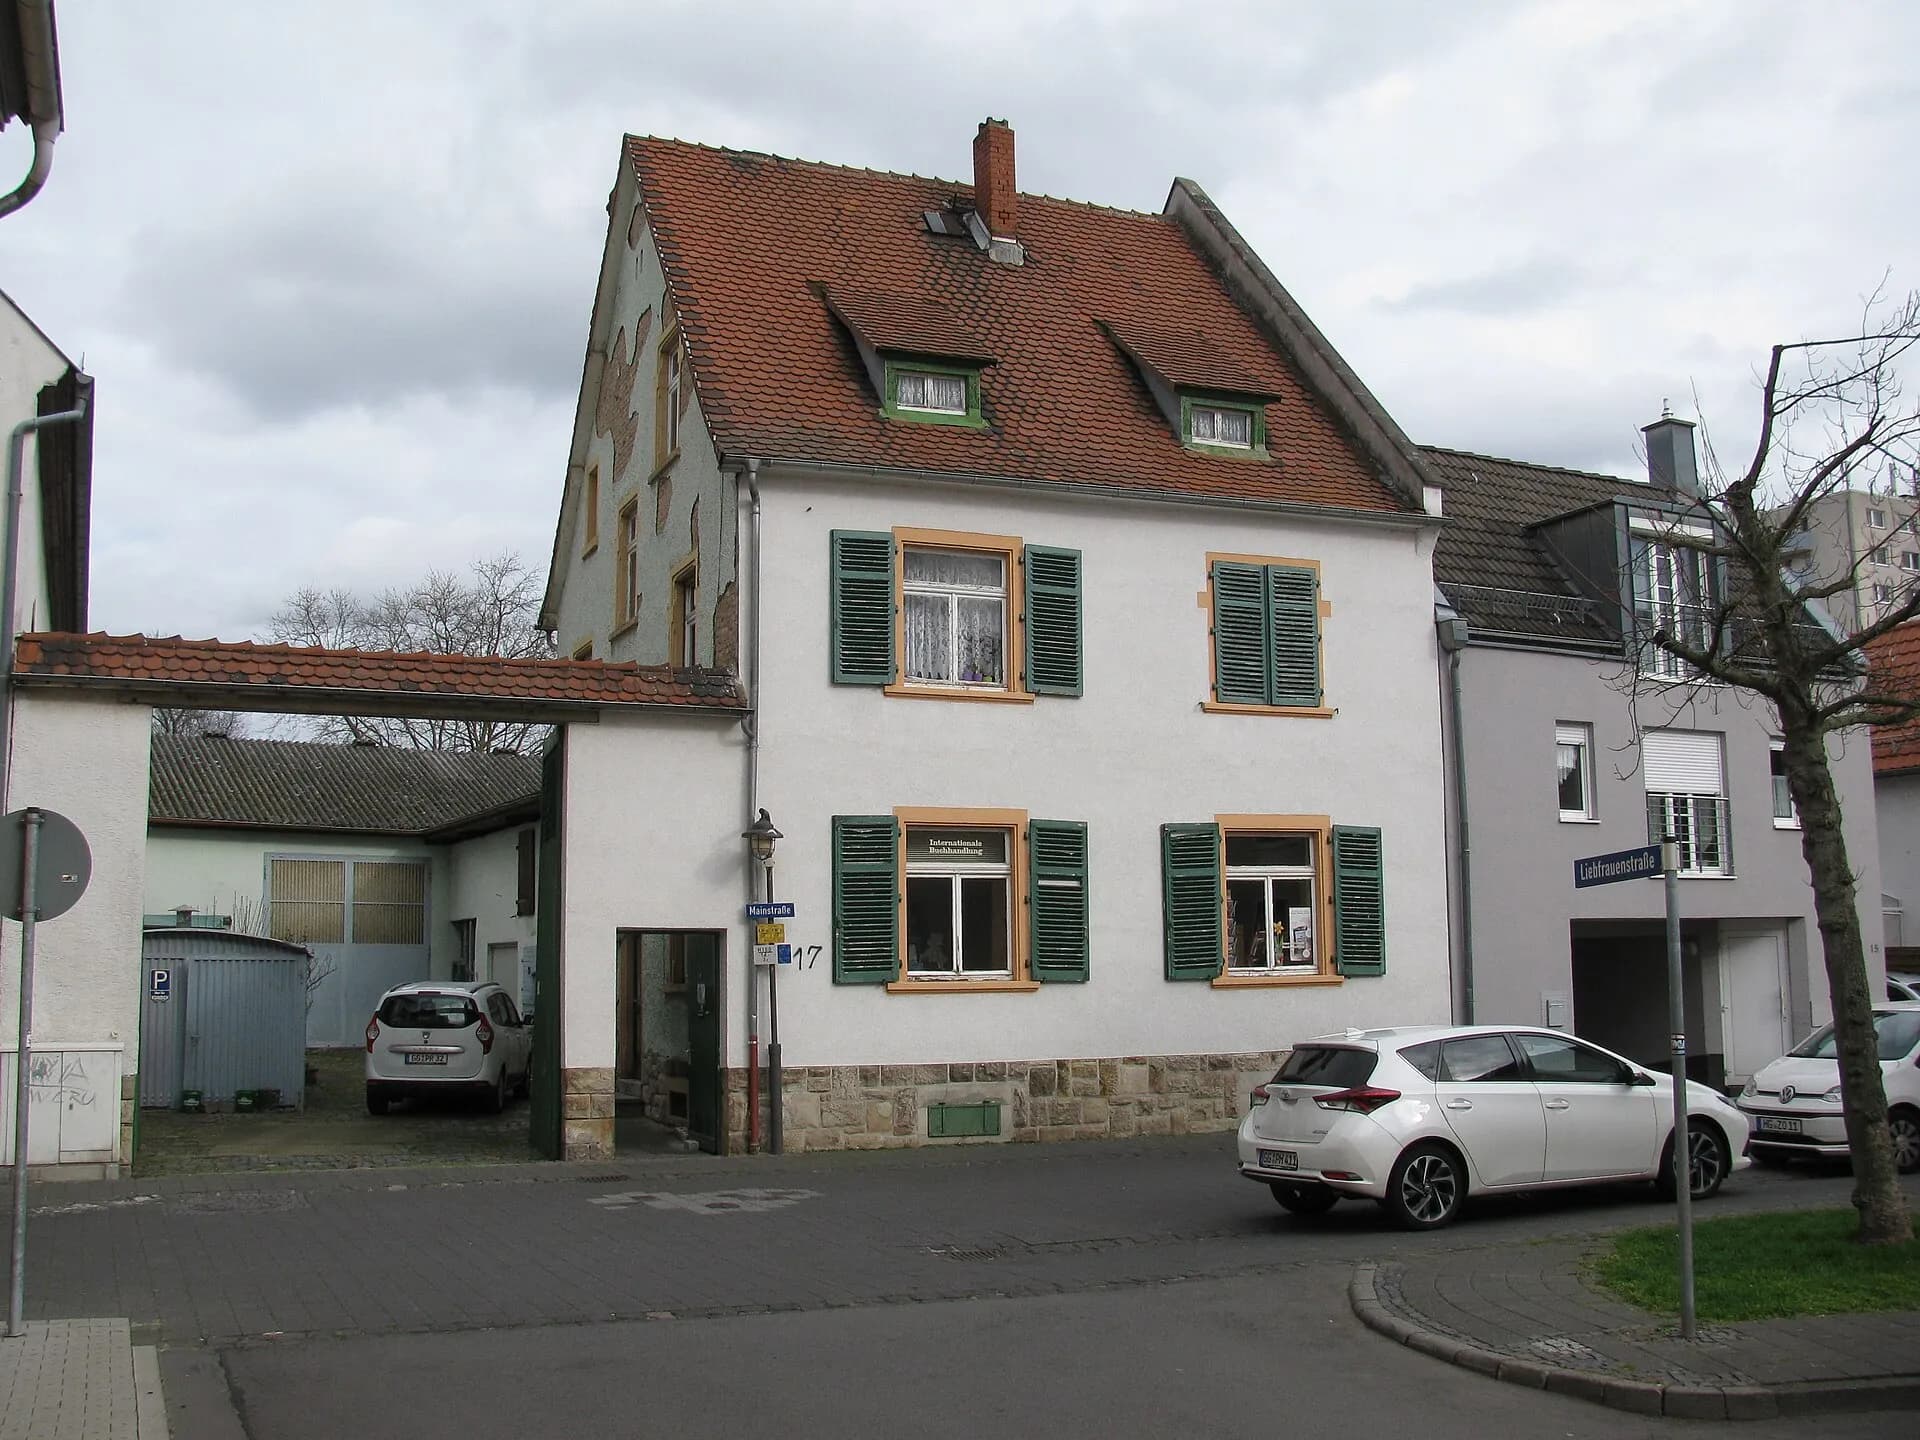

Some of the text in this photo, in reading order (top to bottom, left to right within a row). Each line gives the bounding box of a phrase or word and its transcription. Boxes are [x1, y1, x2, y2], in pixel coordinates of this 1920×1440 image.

[928, 839, 983, 847] Internationale
[928, 847, 984, 856] Buchhandlung
[1580, 851, 1655, 881] Liebfrauenstraße
[749, 905, 791, 916] Mainstraße
[1870, 944, 1879, 953] 15
[793, 945, 823, 971] 17
[154, 970, 168, 990] P
